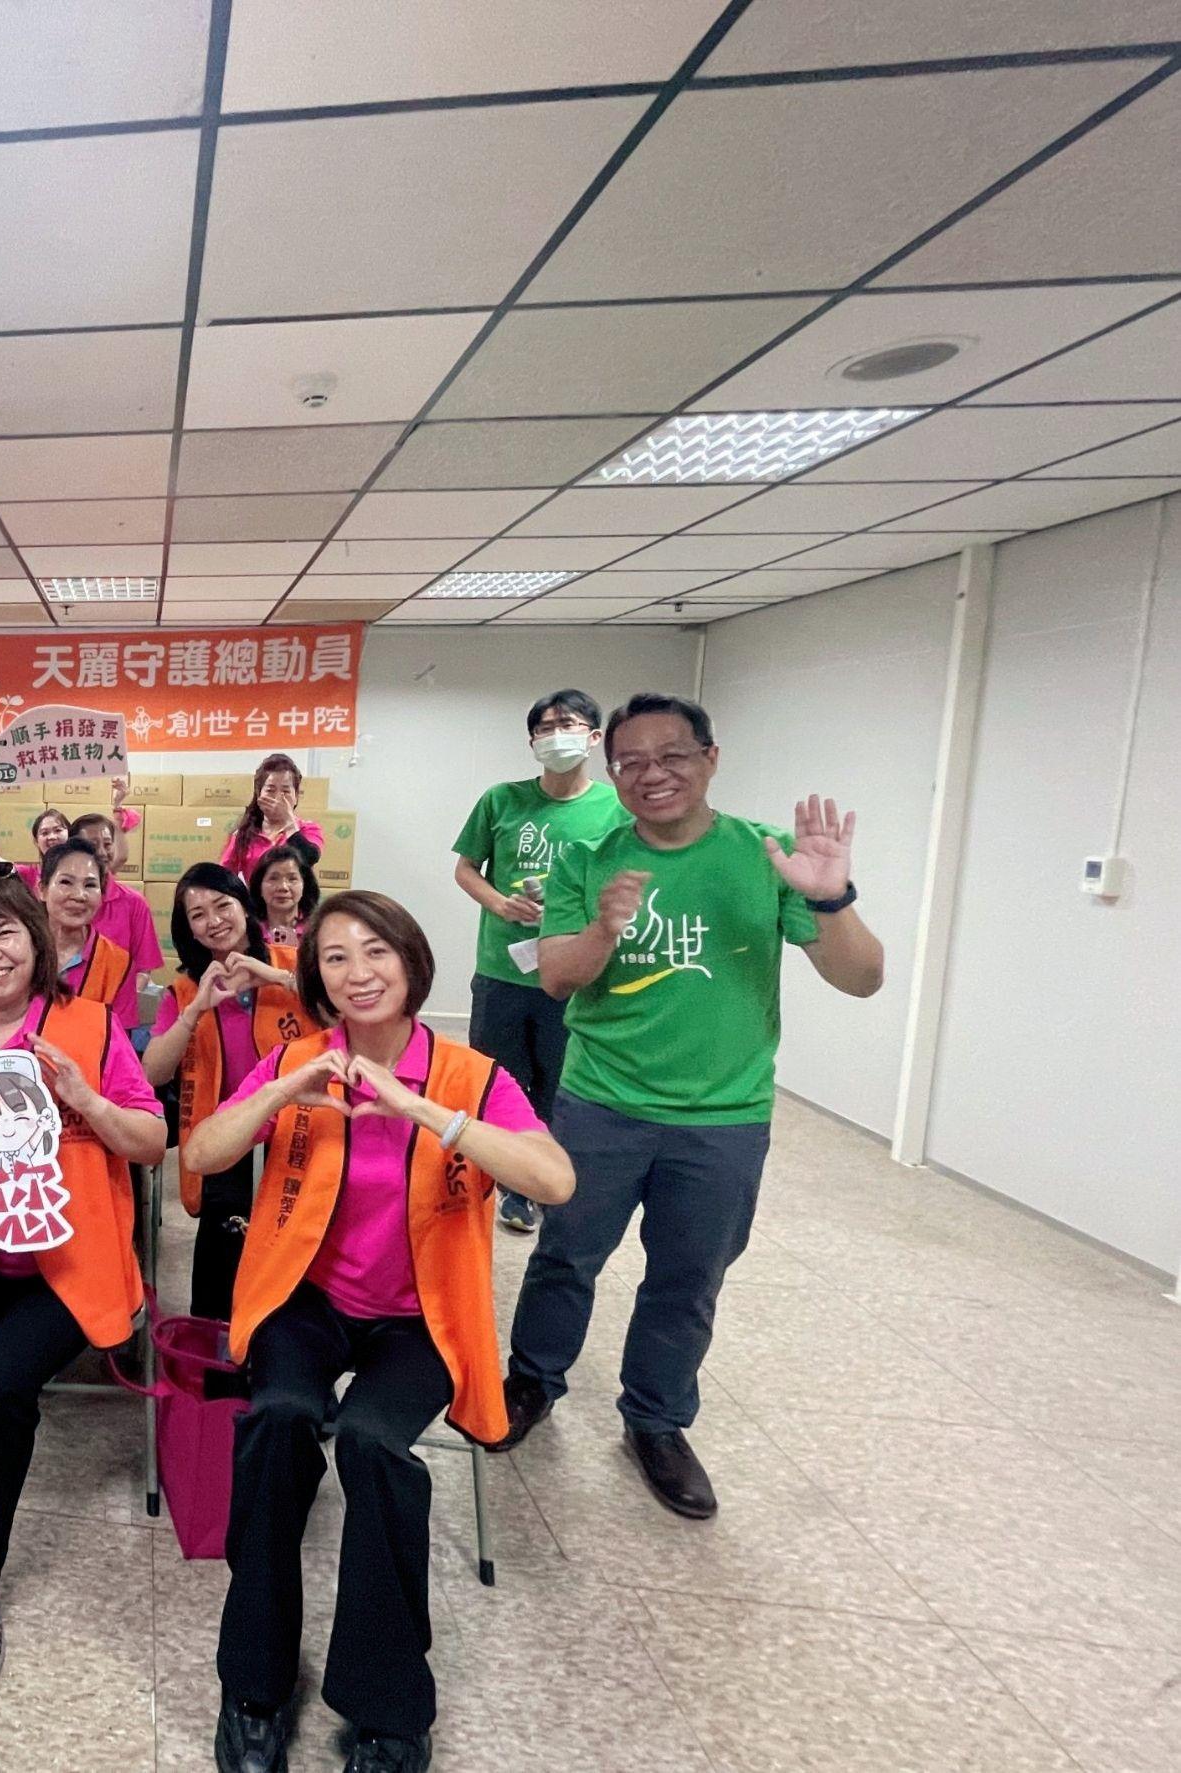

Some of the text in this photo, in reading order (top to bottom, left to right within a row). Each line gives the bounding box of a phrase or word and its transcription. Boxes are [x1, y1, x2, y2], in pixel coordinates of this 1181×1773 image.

[32, 634, 352, 689] 天麗守護總動員
[11, 718, 119, 746] 順手捐發票
[166, 706, 351, 738] 創世台中院
[16, 742, 124, 769] 救救植物人
[620, 953, 656, 964] 1986
